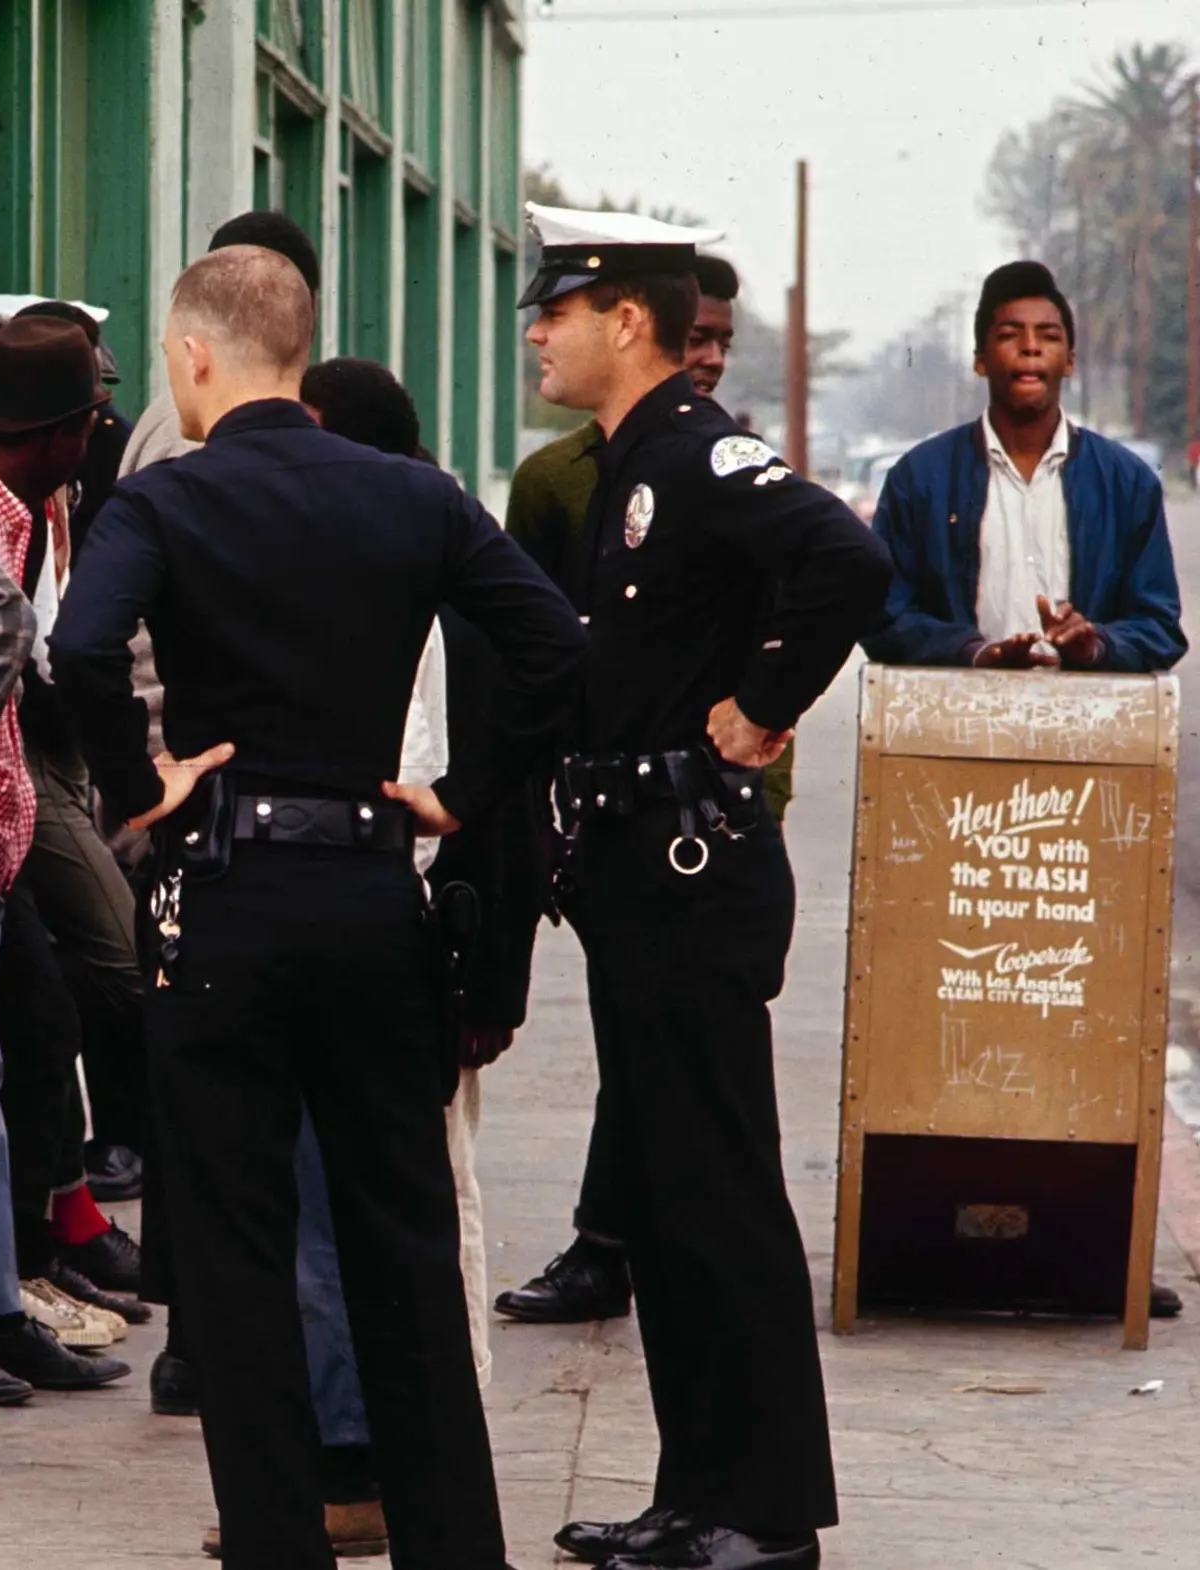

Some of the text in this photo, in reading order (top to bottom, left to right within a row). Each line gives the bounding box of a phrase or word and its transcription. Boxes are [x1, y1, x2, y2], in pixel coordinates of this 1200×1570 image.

[946, 791, 1004, 847] Hey
[1007, 778, 1094, 828] there!
[974, 834, 1090, 864] YOU with
[950, 861, 1088, 893] the TRASH
[948, 890, 1095, 929] in your hand
[995, 936, 1094, 977] Cooperate
[941, 967, 982, 988] With
[986, 970, 1011, 989] Los
[937, 986, 1085, 1007] CLEAN CITY CRUSADE
